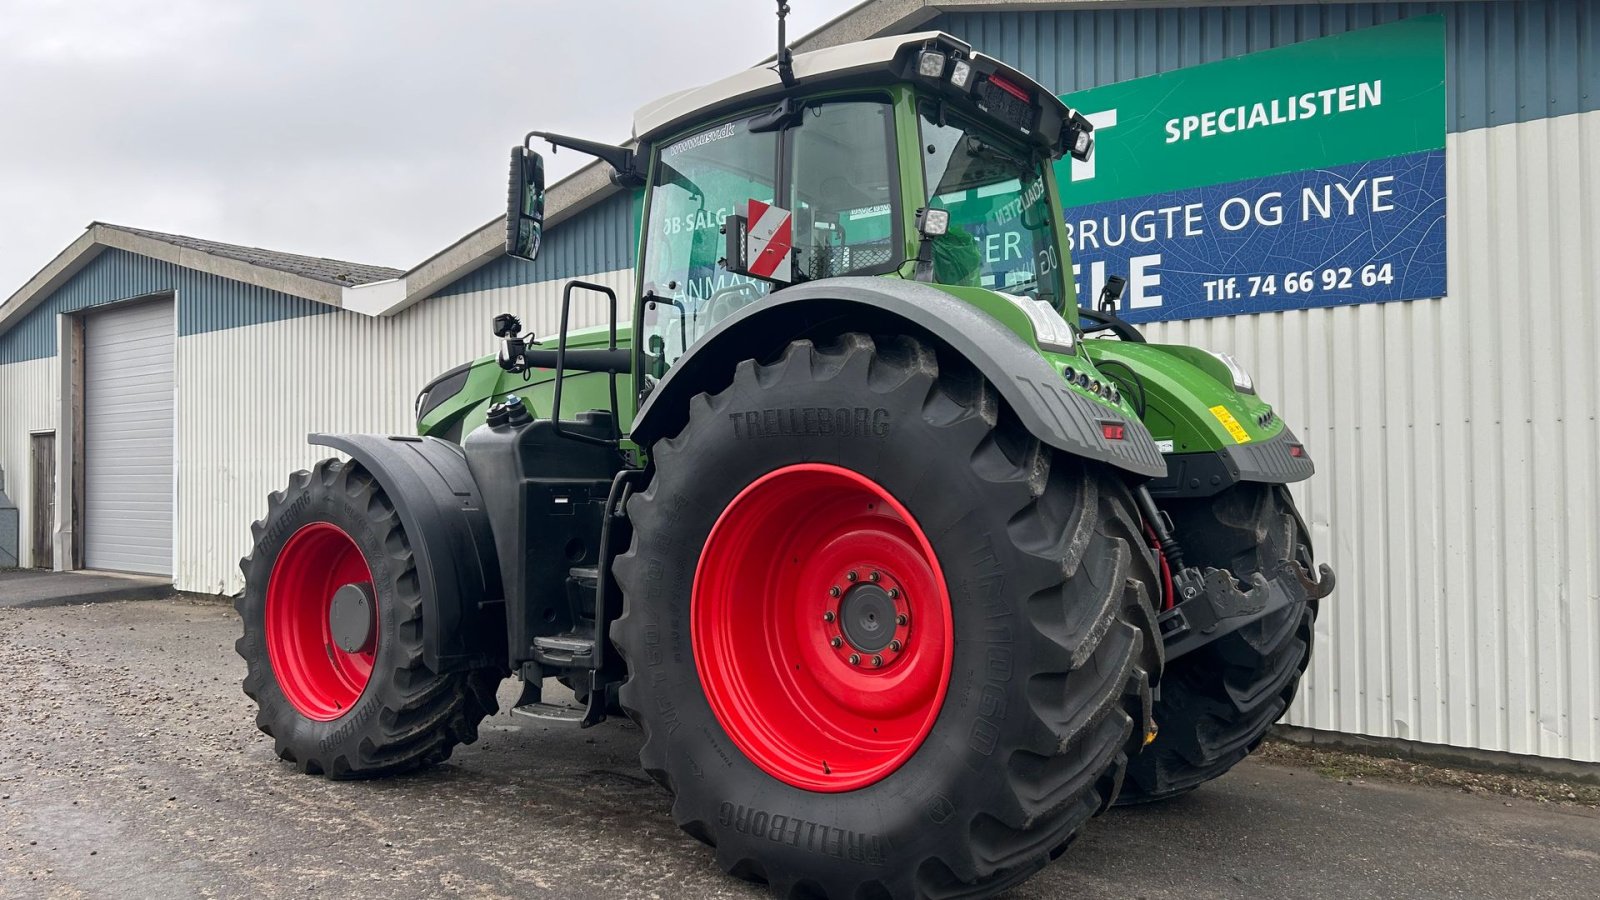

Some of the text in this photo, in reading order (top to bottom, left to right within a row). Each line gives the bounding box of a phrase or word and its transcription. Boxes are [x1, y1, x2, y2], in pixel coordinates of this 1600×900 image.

[1165, 80, 1382, 143] SPECIALISTEN
[1064, 202, 1204, 251] BRUGTE
[1219, 191, 1284, 231] OG
[1302, 176, 1396, 221] NYE
[1203, 263, 1394, 301] Tlf. 74 66 92 64
[728, 407, 890, 440] TRELLEBORG
[257, 490, 312, 554] TRELLEBORG
[718, 801, 888, 867] TRELLEBORG
